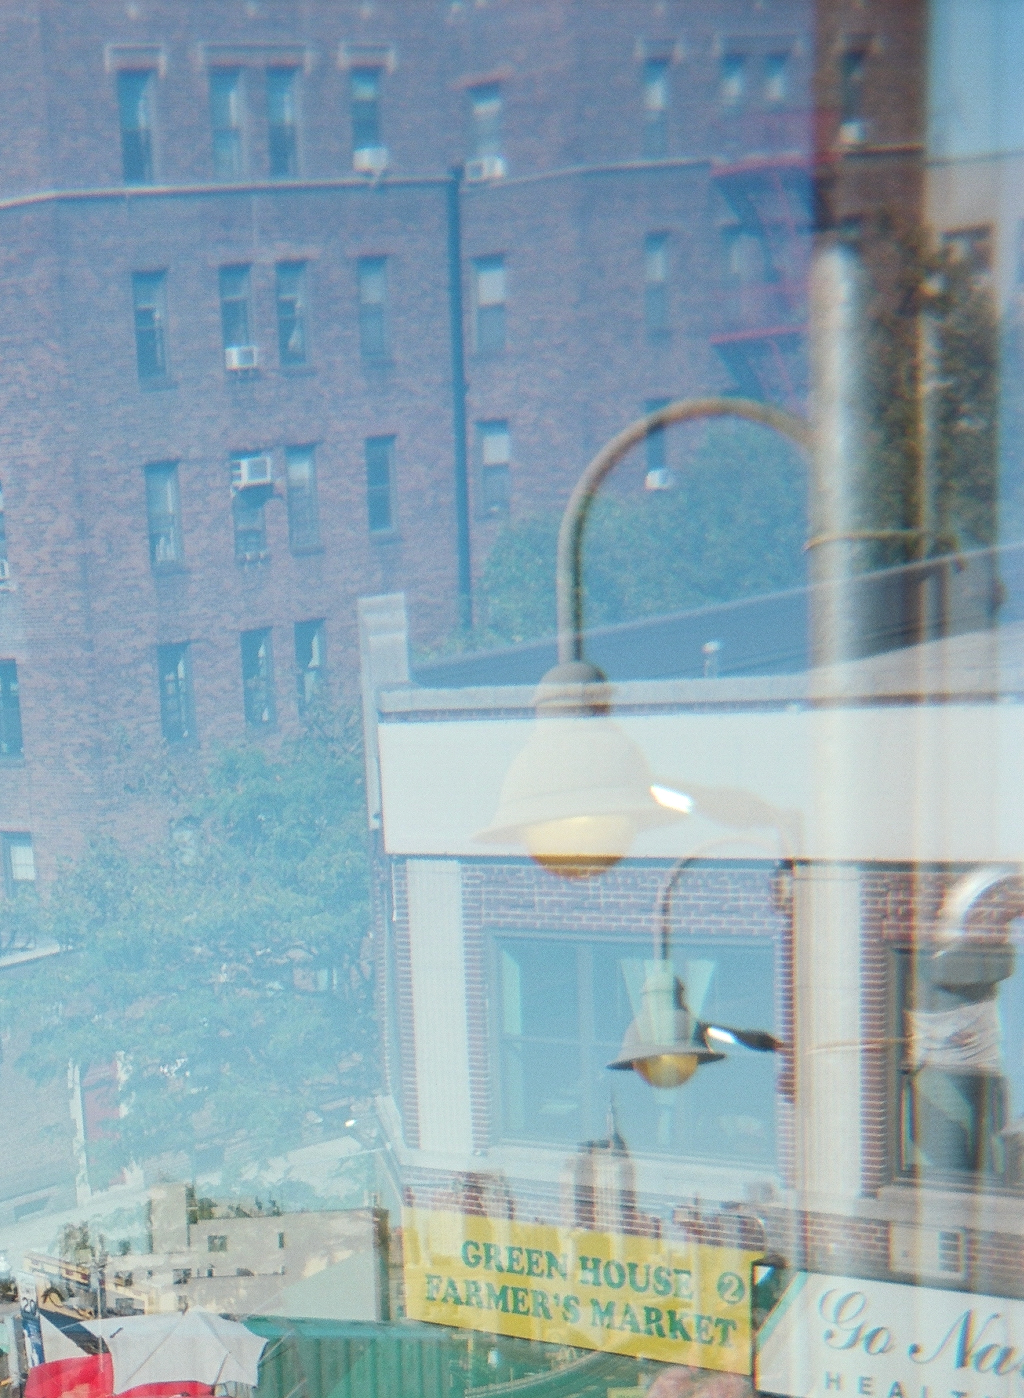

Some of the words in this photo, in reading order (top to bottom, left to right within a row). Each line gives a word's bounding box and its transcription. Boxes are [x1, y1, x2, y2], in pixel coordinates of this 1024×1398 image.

[461, 1240, 569, 1281] GREEN
[578, 1256, 694, 1301] HOUSE
[21, 1296, 38, 1315] 20
[426, 1274, 580, 1324] FARMER'S
[590, 1301, 737, 1347] MARKET
[818, 1288, 893, 1356] Go
[907, 1309, 1024, 1376] Na
